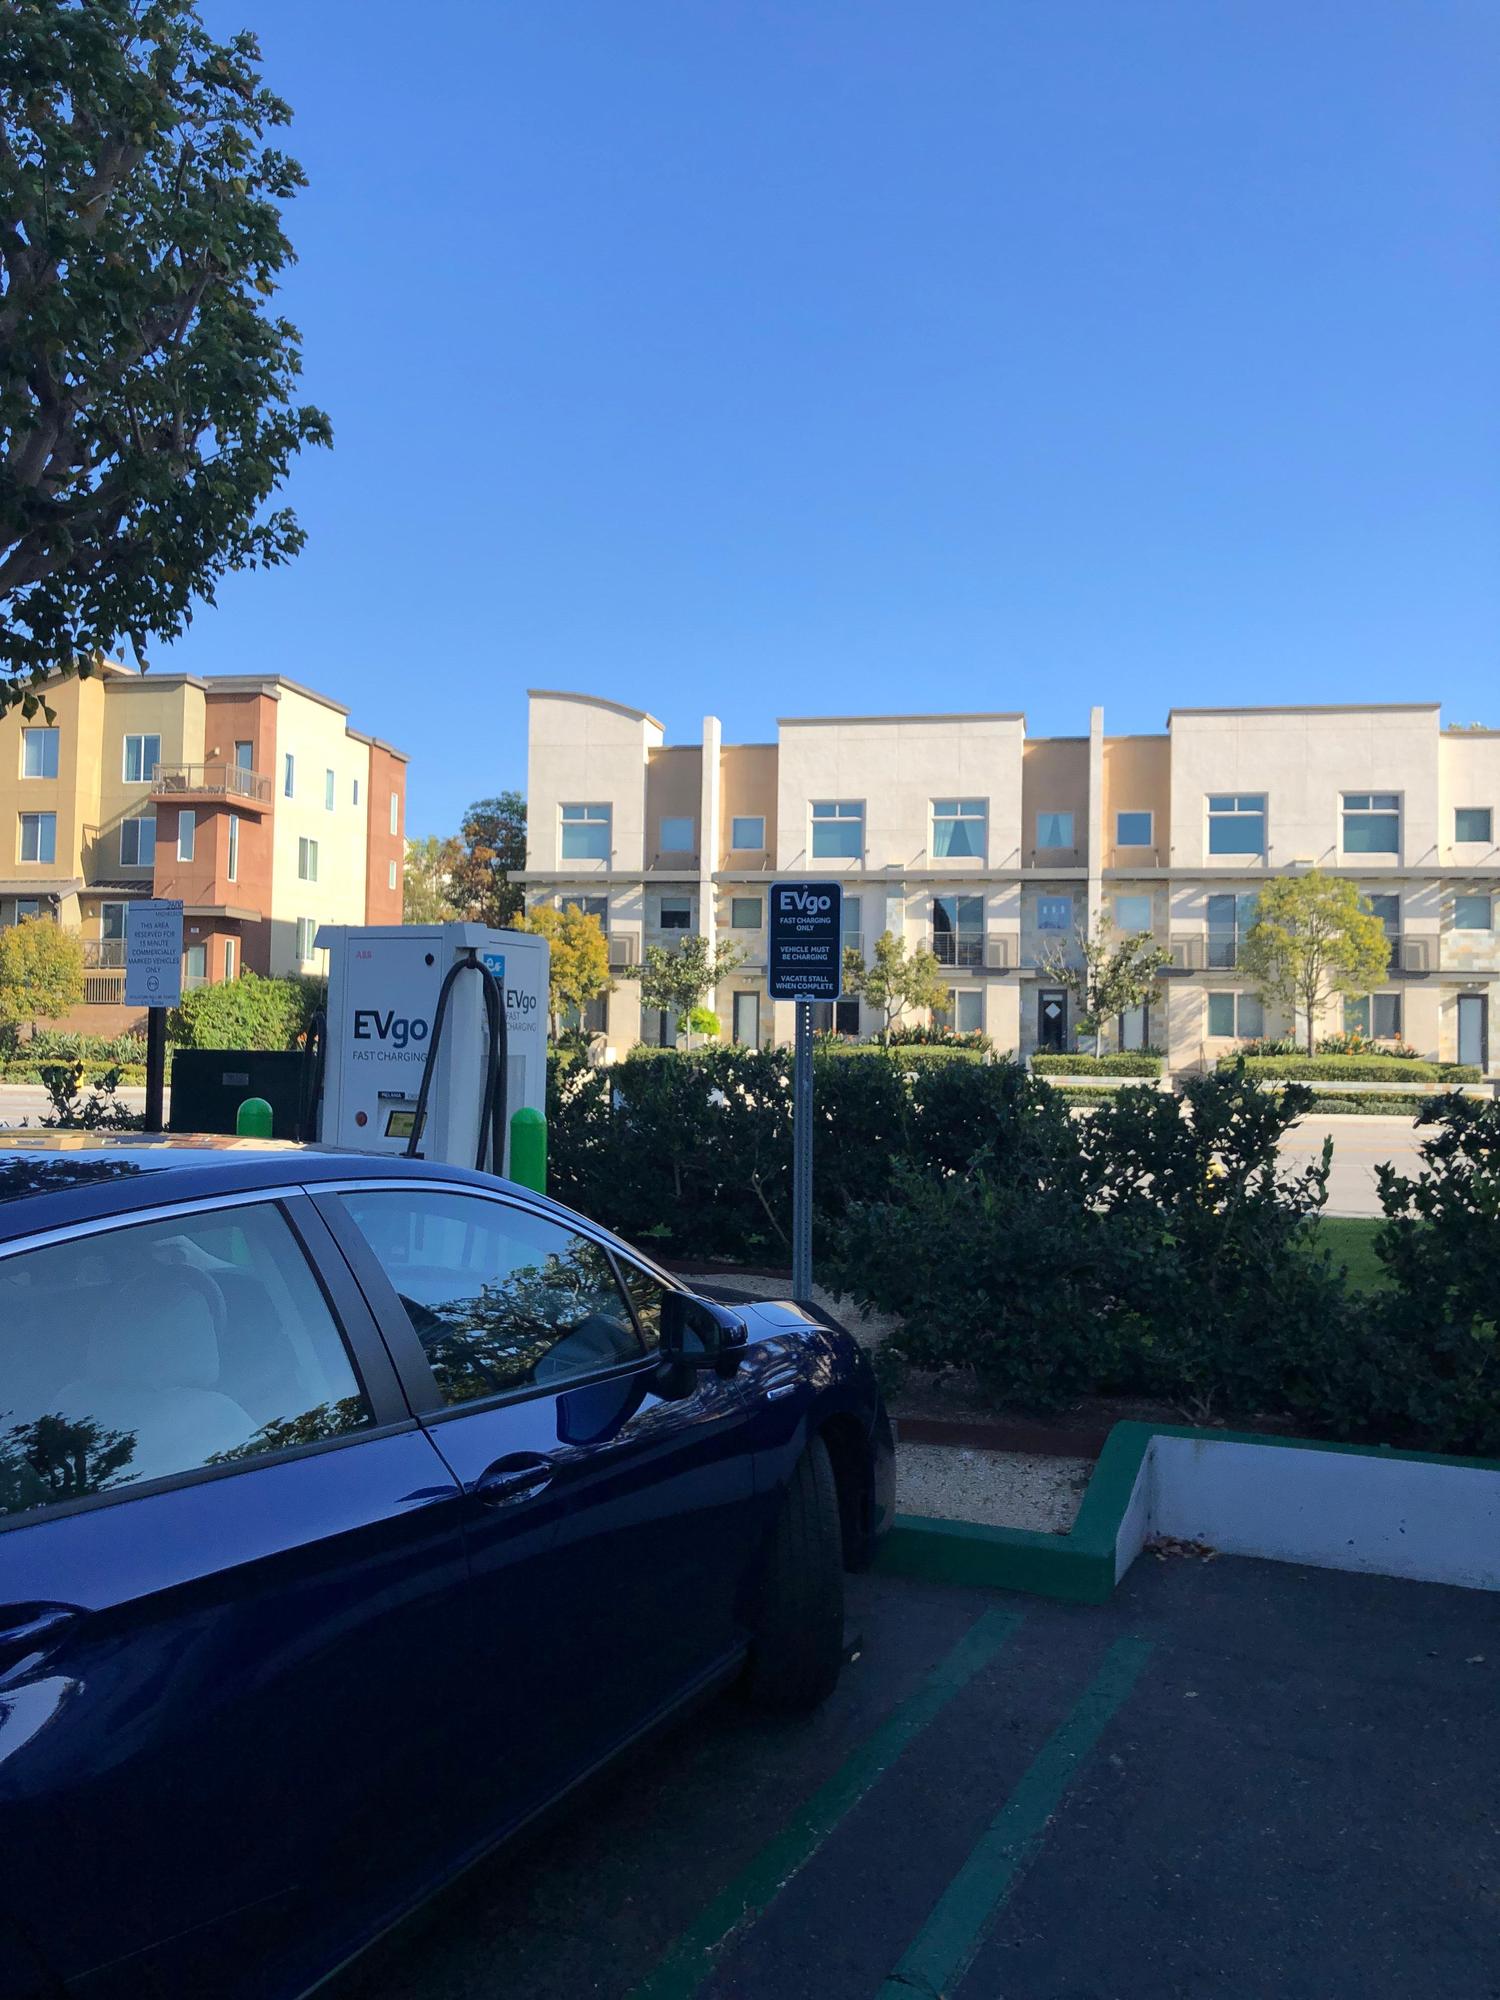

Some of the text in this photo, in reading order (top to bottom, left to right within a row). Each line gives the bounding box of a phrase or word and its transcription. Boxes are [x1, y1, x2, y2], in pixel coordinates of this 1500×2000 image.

[780, 891, 831, 915] EVgo
[507, 989, 536, 1014] EVgo
[354, 1010, 428, 1048] EVgo
[353, 1051, 428, 1062] FAST CHARGING
